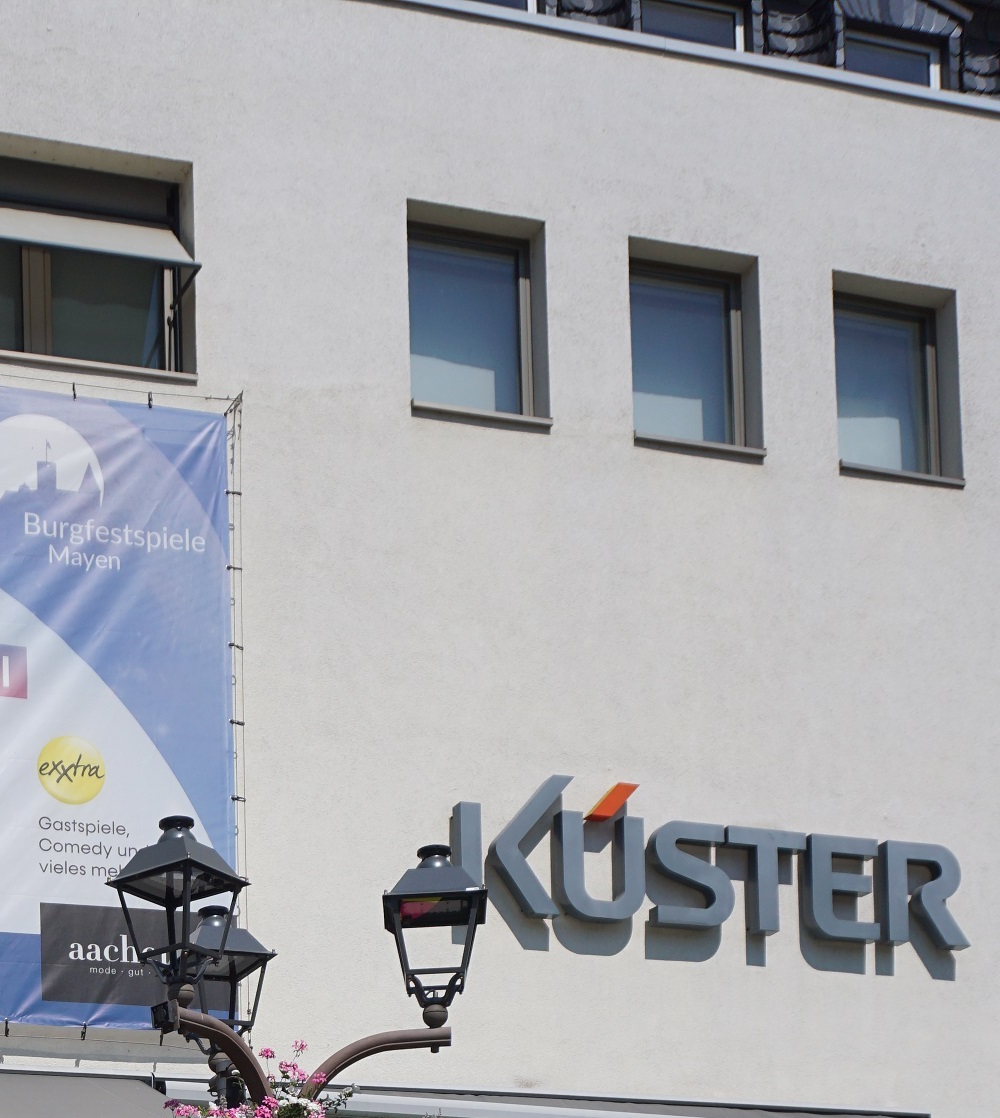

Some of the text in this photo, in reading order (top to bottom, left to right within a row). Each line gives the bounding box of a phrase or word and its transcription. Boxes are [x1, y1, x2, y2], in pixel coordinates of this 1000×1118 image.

[24, 511, 206, 552] Burgfestspiele
[49, 544, 121, 571] Mayen
[39, 753, 105, 784] exxtra
[38, 816, 130, 838] Gastspiele,
[38, 838, 149, 859] Comedy un
[39, 860, 122, 877] vieles me
[452, 774, 971, 950] KÜSTER
[89, 966, 144, 977] mode gut
